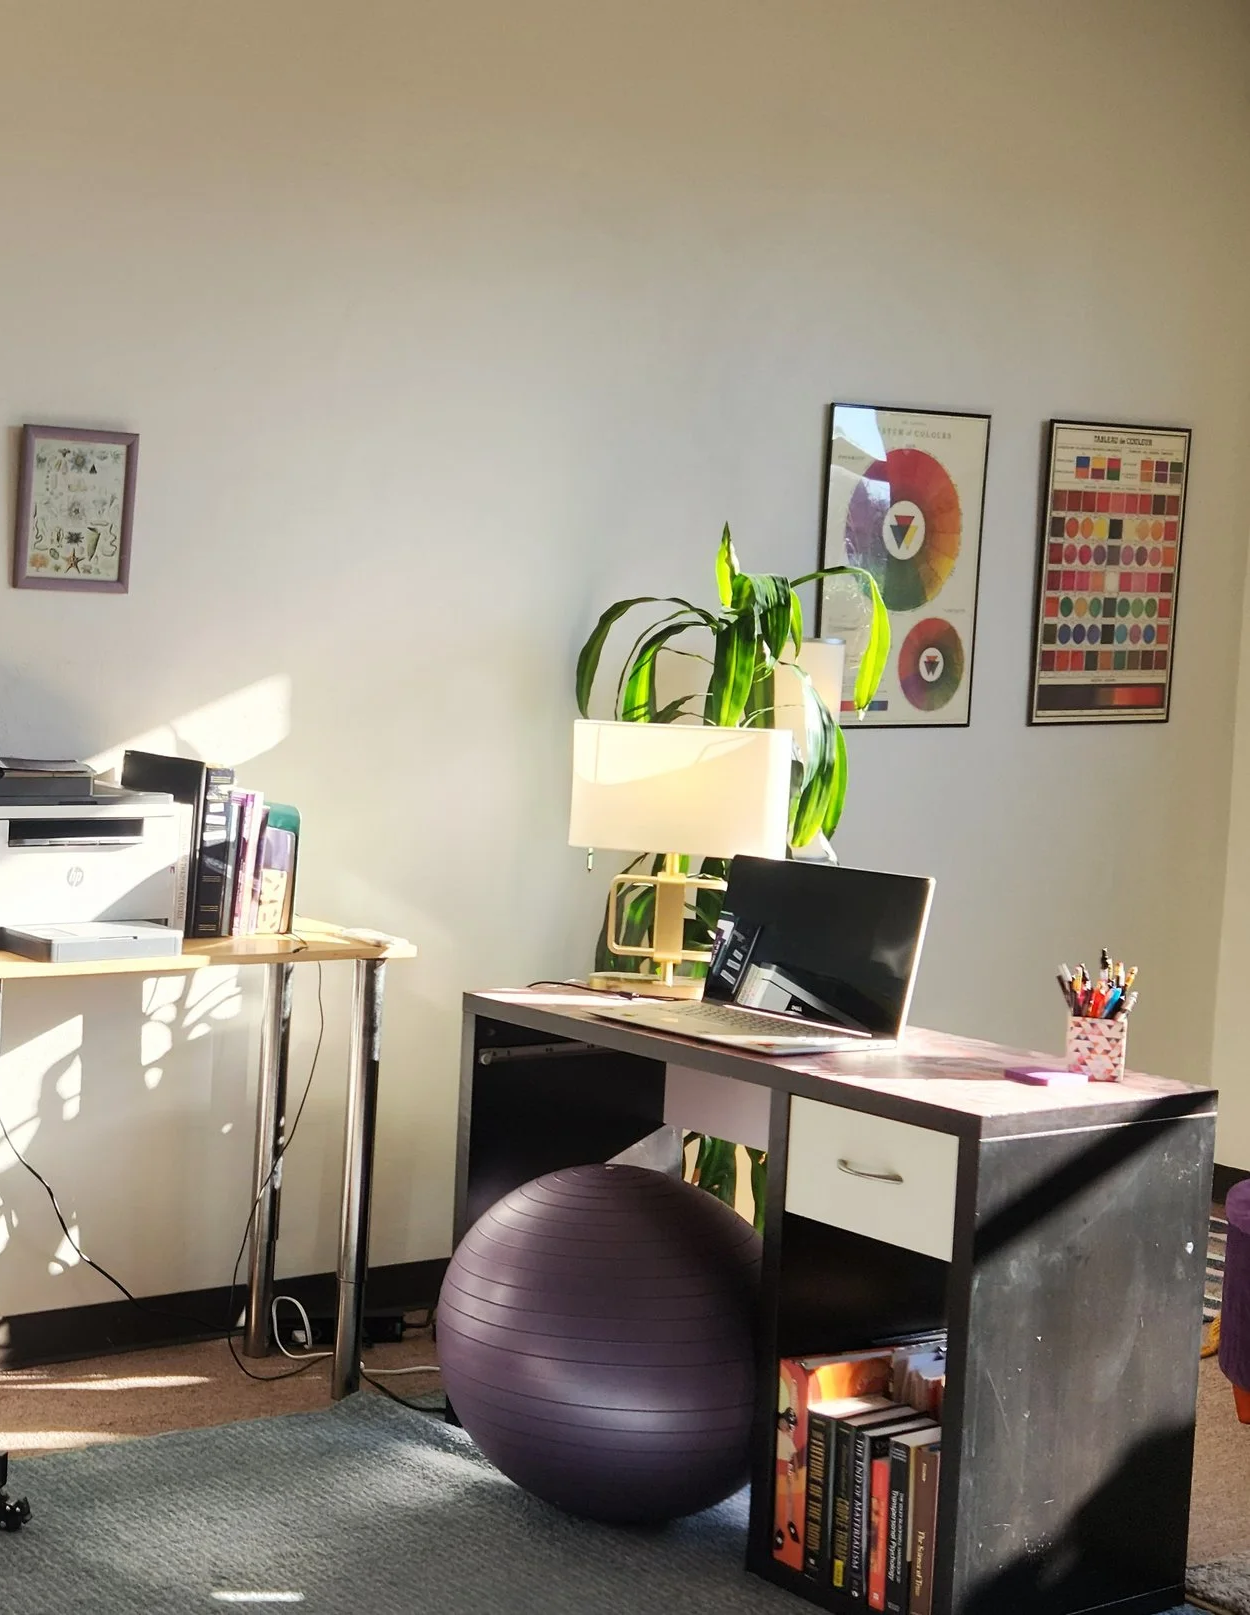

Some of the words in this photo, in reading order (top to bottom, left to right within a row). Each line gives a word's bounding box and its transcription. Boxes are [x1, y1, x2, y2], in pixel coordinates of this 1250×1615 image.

[67, 866, 84, 887] hp
[810, 1438, 825, 1484] FUTURE
[855, 1439, 864, 1456] THE
[854, 1460, 863, 1484] END
[835, 1497, 849, 1527] COUPLE
[890, 1490, 899, 1540] Transpersonal
[852, 1499, 862, 1570] MATERIALISM
[917, 1530, 926, 1543] The
[888, 1540, 896, 1581] Psychology
[916, 1545, 925, 1569] Science
